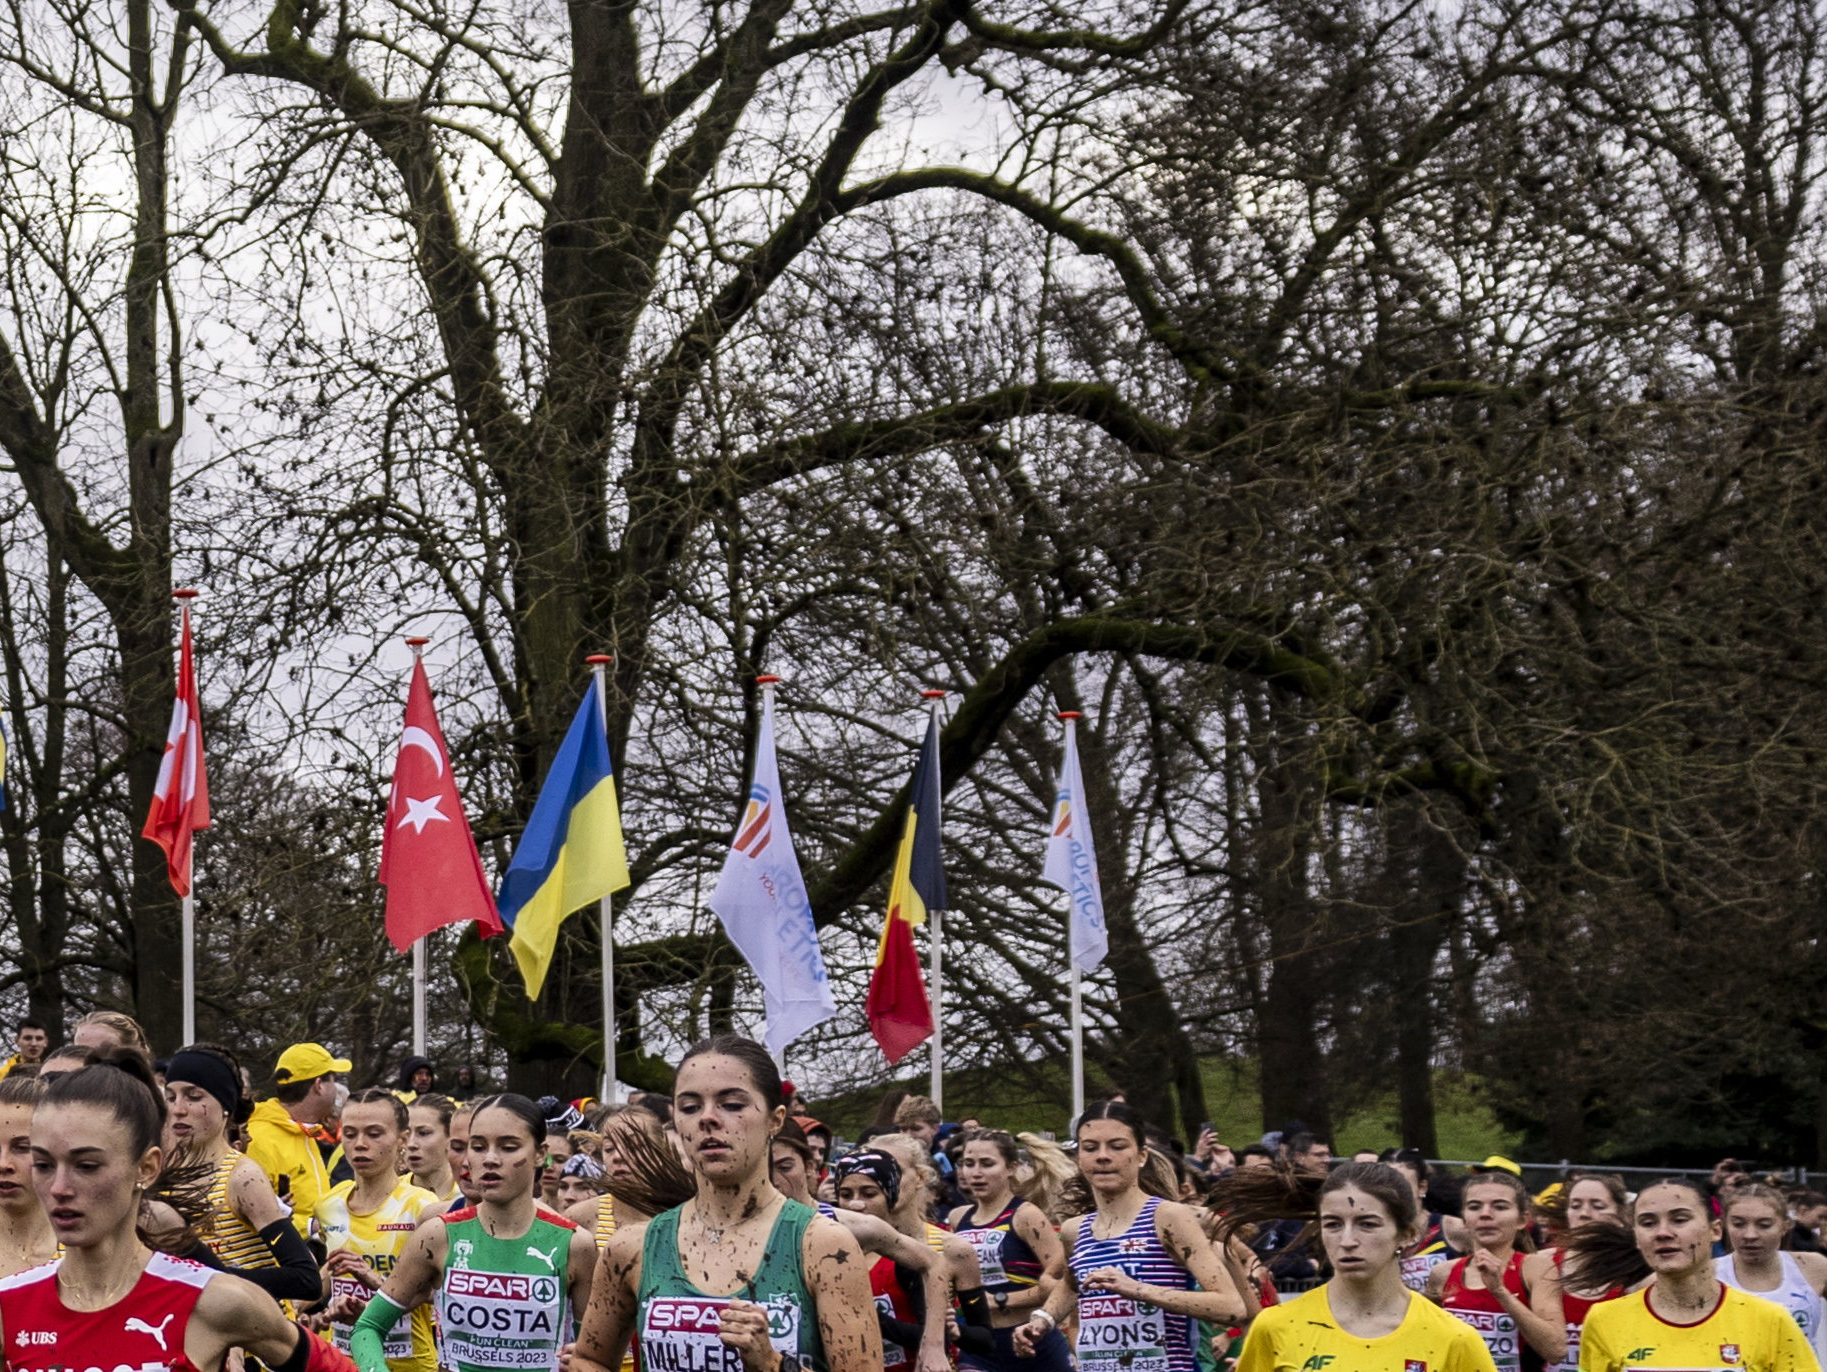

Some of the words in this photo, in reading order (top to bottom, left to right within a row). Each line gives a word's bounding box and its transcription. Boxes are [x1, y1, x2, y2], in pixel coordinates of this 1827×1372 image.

[449, 1273, 528, 1298] SPAR
[447, 1301, 552, 1334] COSTA
[651, 1304, 722, 1329] SPA
[1081, 1300, 1134, 1318] SPAR
[31, 1332, 58, 1345] UBS
[1079, 1322, 1159, 1346] LYONS
[451, 1342, 514, 1362] BRUSSELS
[516, 1351, 548, 1363] 2023
